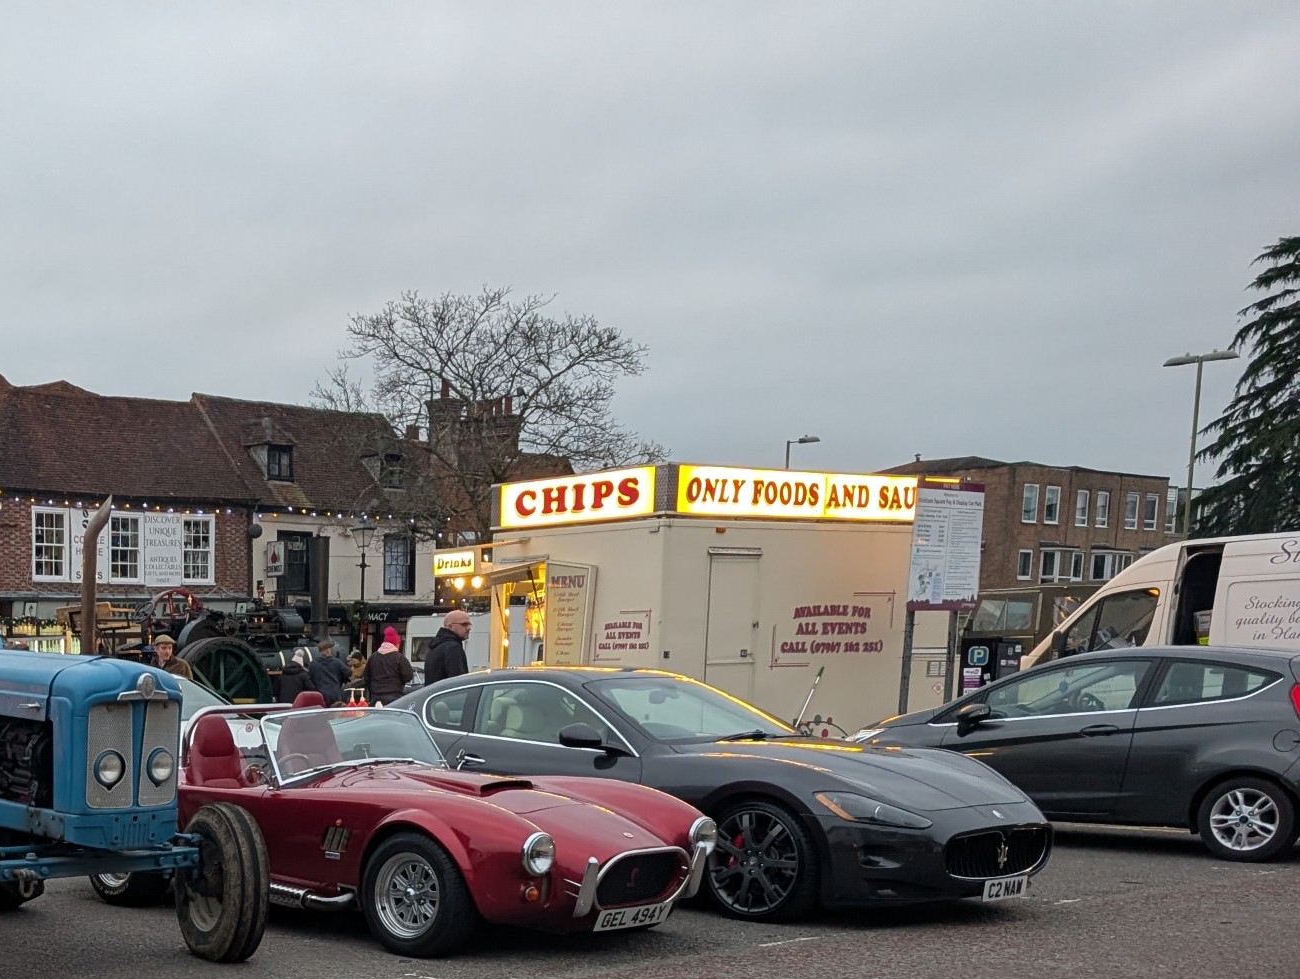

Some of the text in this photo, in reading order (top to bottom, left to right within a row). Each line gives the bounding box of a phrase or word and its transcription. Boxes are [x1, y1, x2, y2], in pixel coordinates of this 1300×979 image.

[515, 477, 640, 517] CHIPS
[686, 476, 917, 510] ONLY FOODS AND SAU
[145, 515, 180, 524] DISCOVER
[150, 527, 177, 537] UNIQUE
[145, 539, 182, 547] TREASURES
[150, 556, 177, 564] ANTIQUES
[437, 557, 472, 570] Drinks
[551, 575, 585, 588] MENU
[793, 604, 871, 619] AVAILABLE FOR
[604, 621, 643, 630] AVAILABLE FOR
[1235, 612, 1285, 629] quality
[605, 631, 641, 639] ALL EVENTS
[795, 622, 867, 636] ALL EVENTS
[1252, 630, 1268, 641] in
[598, 642, 611, 650] CALL
[780, 641, 807, 653] CALL
[862, 639, 884, 653] 251)
[988, 881, 1003, 898] C2
[601, 904, 667, 928] GEL 494Y
